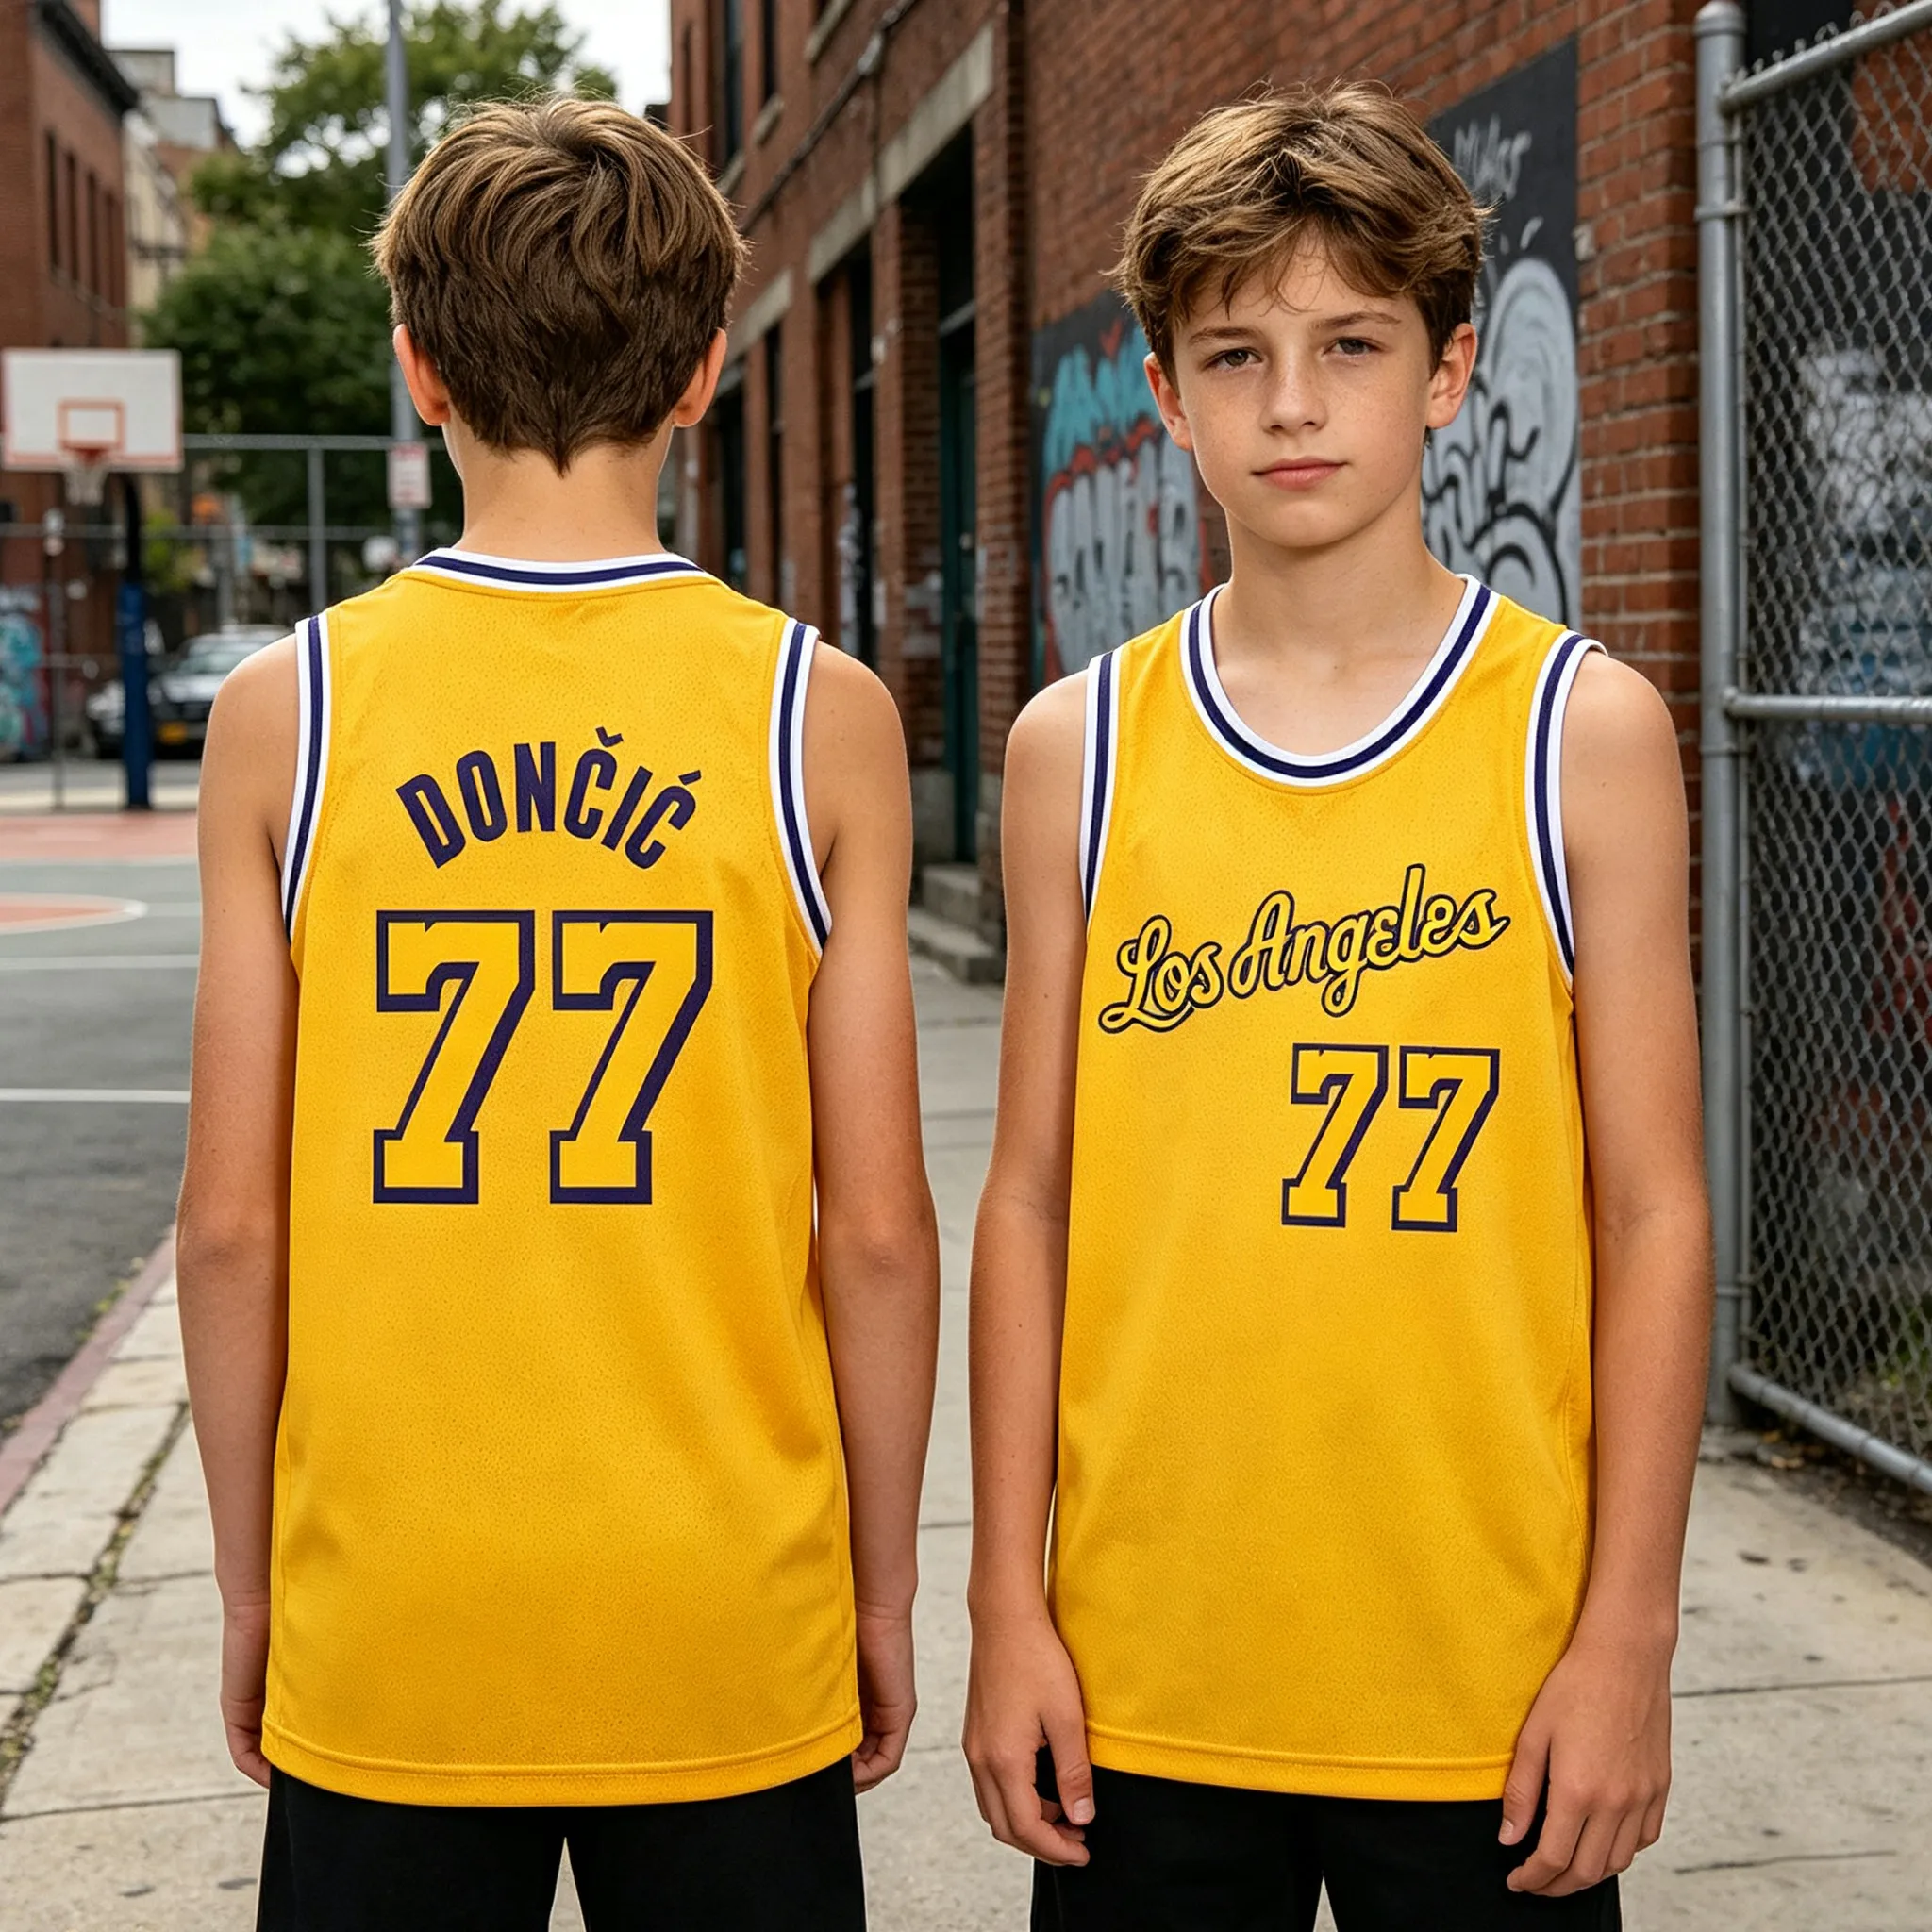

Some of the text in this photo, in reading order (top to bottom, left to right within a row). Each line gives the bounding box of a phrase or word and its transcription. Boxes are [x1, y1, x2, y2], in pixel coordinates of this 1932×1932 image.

[395, 726, 702, 870] DONČIĆ
[1098, 862, 1512, 1034] Los Angeles
[372, 909, 714, 1205] 77
[1280, 1042, 1501, 1233] 77
